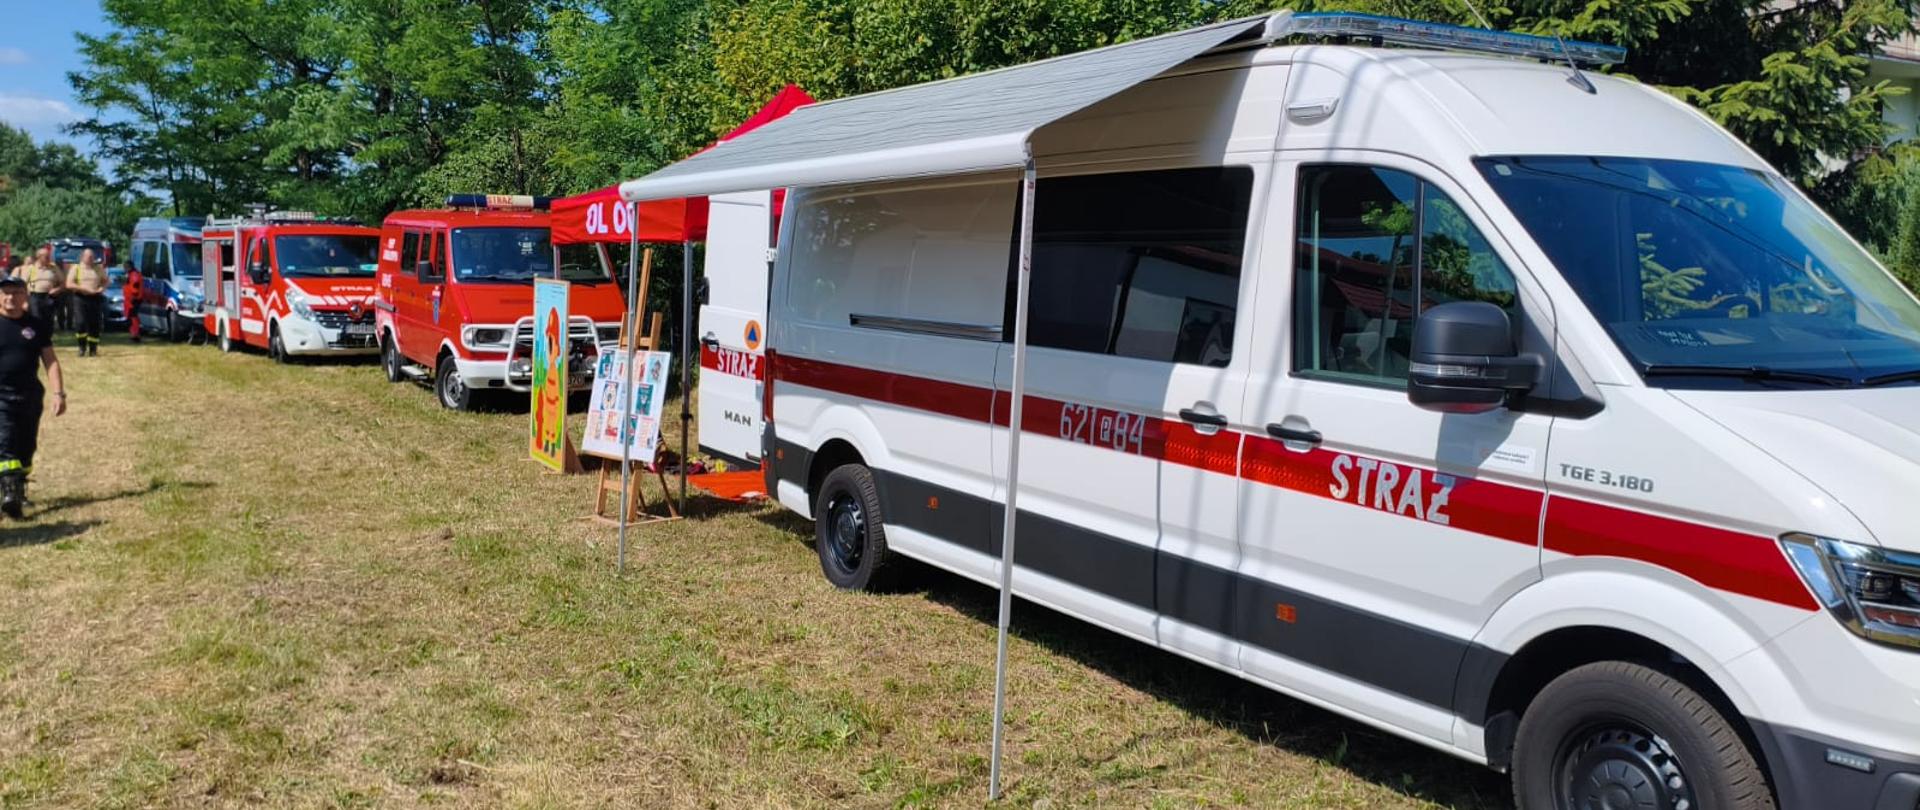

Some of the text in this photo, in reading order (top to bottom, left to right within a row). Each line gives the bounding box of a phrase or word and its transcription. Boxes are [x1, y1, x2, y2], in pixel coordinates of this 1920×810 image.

[724, 409, 752, 427] MAN
[1559, 463, 1655, 493] TGE 3.180
